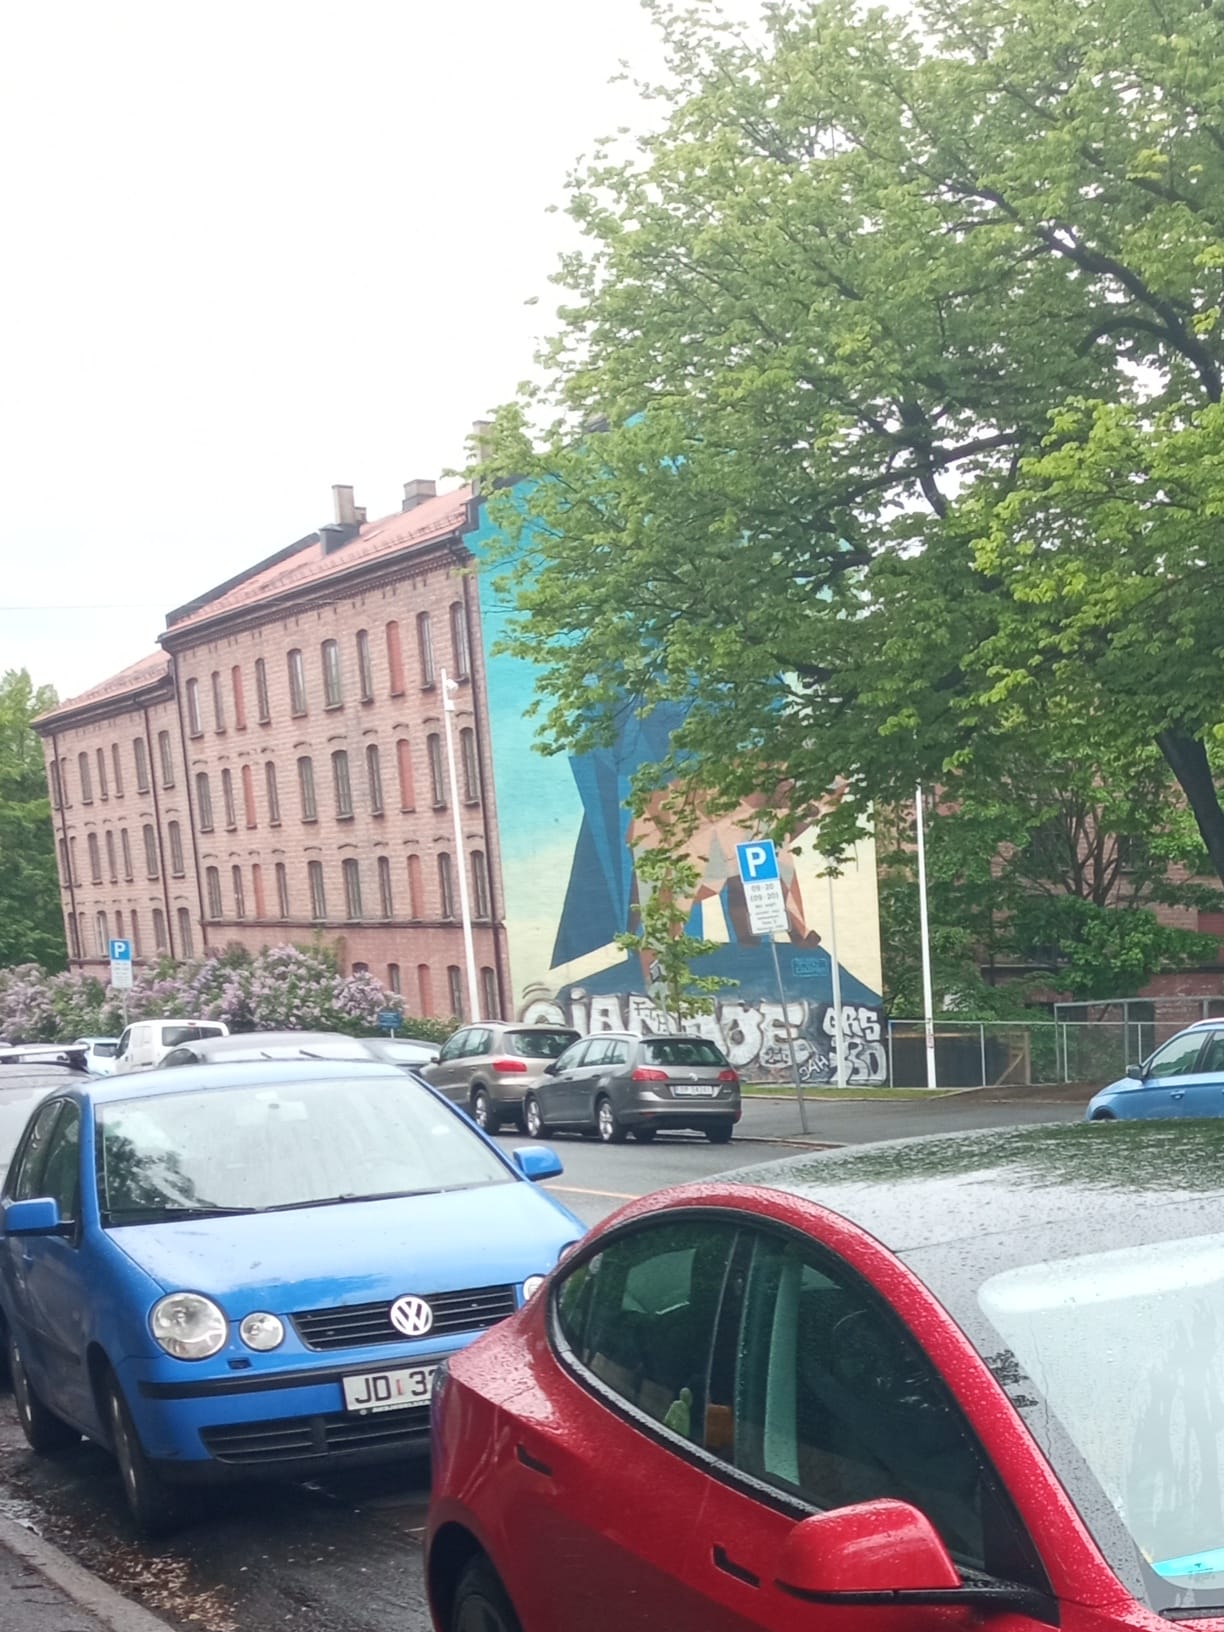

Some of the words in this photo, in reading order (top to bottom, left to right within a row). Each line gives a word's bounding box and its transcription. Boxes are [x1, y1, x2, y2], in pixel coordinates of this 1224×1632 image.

[745, 847, 767, 878] P
[114, 941, 126, 958] P
[355, 1375, 391, 1404] JD
[409, 1369, 436, 1396] 3
